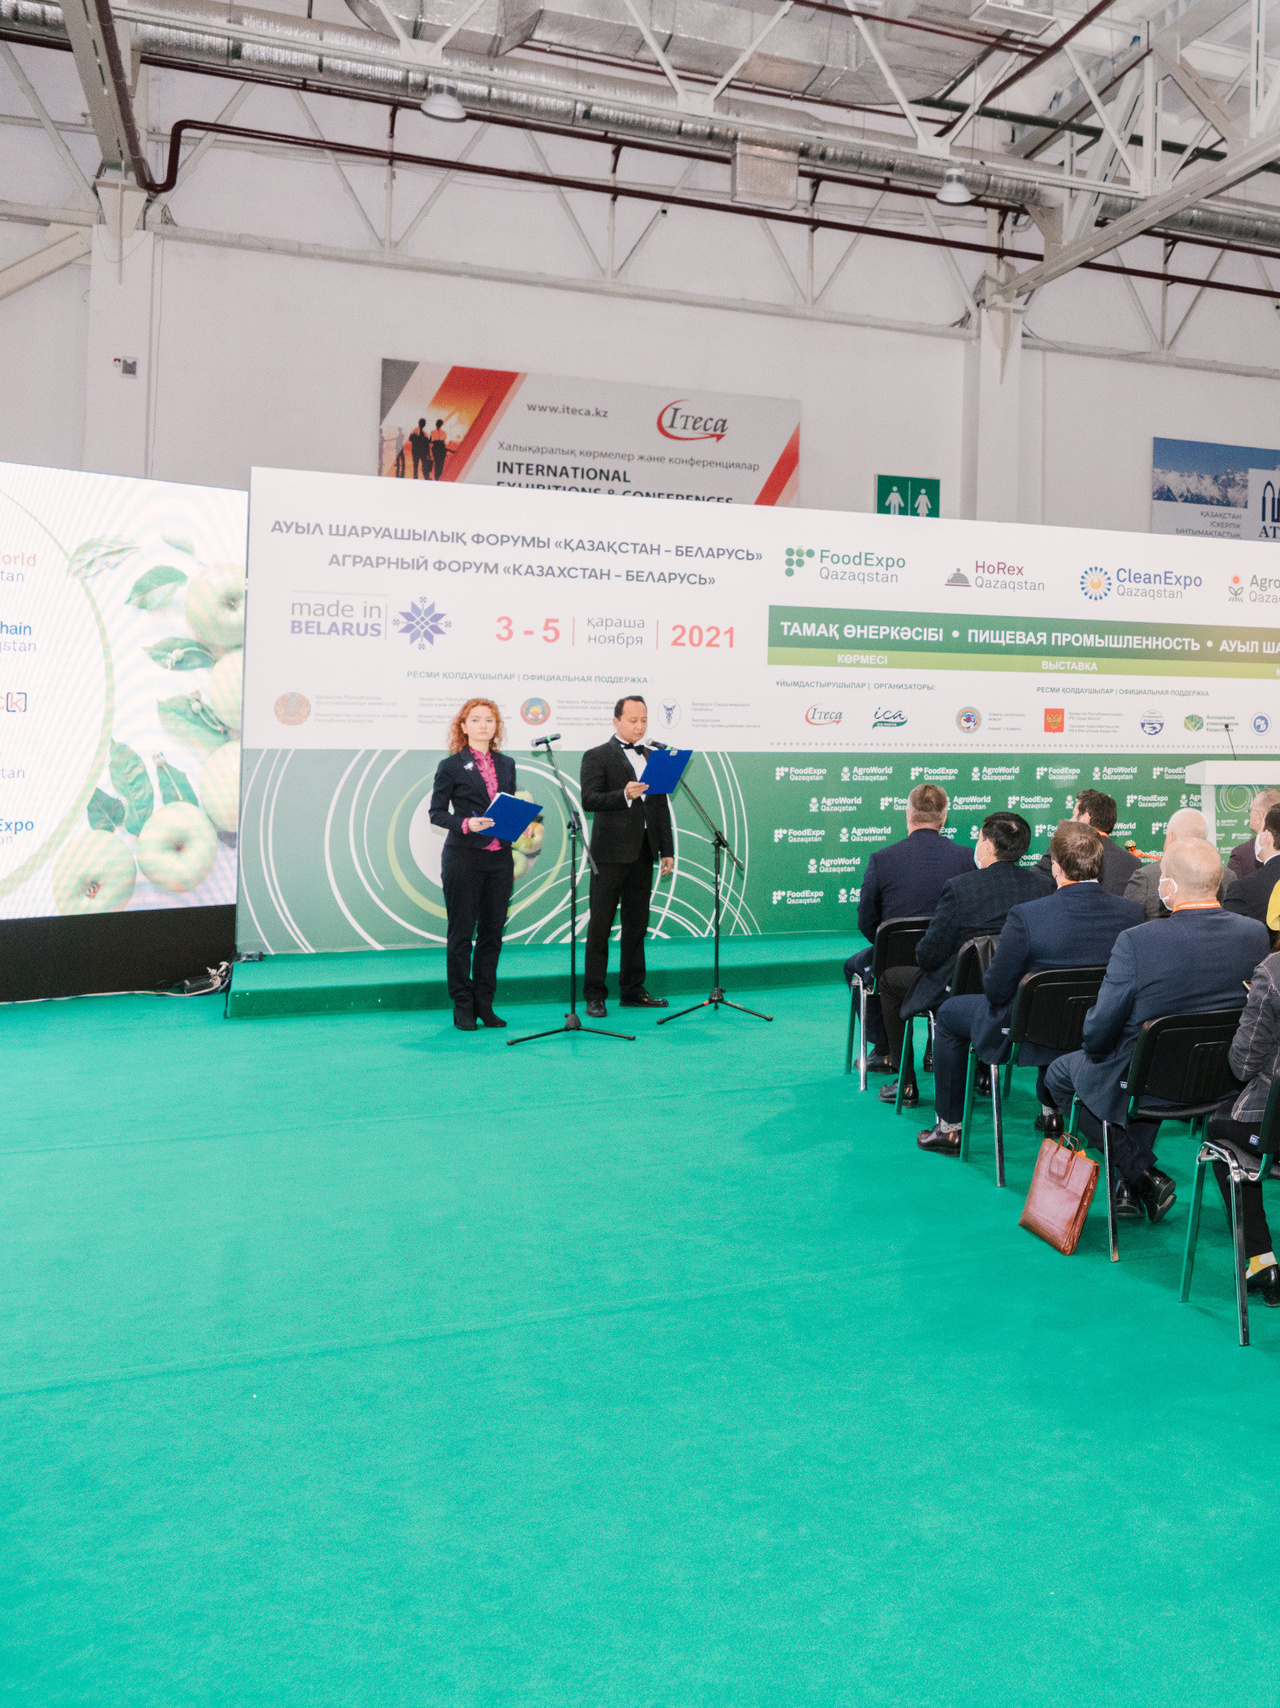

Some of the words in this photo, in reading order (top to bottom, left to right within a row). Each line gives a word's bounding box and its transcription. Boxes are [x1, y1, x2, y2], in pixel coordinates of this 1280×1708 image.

[527, 402, 609, 418] www.iteca.kz
[498, 441, 577, 457] Халықаралық
[579, 450, 634, 464] көрмелер
[668, 455, 760, 472] конференциялар
[496, 461, 631, 483] INTERNATIONAL
[270, 520, 324, 536] АУЫЛ
[328, 524, 467, 546] ШАРУАШЫЛЫҚ
[471, 533, 550, 549] ФОРУМЫ
[675, 545, 763, 561] БЕЛАРУСЬ»
[0, 552, 36, 566] orld
[820, 549, 906, 571] FoodExpo
[328, 554, 428, 571] АГРАРНЫЙ
[432, 560, 498, 575] ФОРУМ
[625, 570, 715, 585] БЕЛАРУСЬ»
[819, 566, 899, 584] Qazaqstan
[975, 560, 1024, 576] HoRex
[975, 576, 1045, 592] Qazaqstan
[1116, 568, 1203, 590] CleanExpo
[1116, 584, 1183, 600] Qazaqstan
[291, 600, 354, 618] made
[364, 602, 382, 618] in
[290, 620, 382, 637] BELARUS
[587, 616, 645, 630] қараша
[588, 633, 643, 648] ноября
[670, 624, 734, 648] 2021
[780, 621, 839, 640] ТАМАҚ
[843, 624, 944, 642] ӨНЕРКӘСІБІ
[968, 628, 1047, 647] ПИЩЕВАЯ
[1051, 632, 1200, 652] ПРОМЫШЛЕННОСТЬ
[1220, 639, 1259, 654] АУЫЛ
[837, 653, 888, 665] КӨРМЕСІ
[1042, 660, 1098, 671] ВЫСТАВКА
[407, 670, 440, 679] РЕСМИ
[442, 672, 515, 681] ҚОЛДАУШЫЛАР
[522, 674, 592, 683] ОФИЦИАЛЬНАЯ
[790, 767, 827, 775] FoodExpo
[852, 766, 893, 775] AgroWorld
[923, 767, 958, 775] FoodExpo
[821, 797, 862, 805] AgroWorld
[788, 828, 825, 836] FoodExpo
[820, 857, 860, 866] AgroWorld
